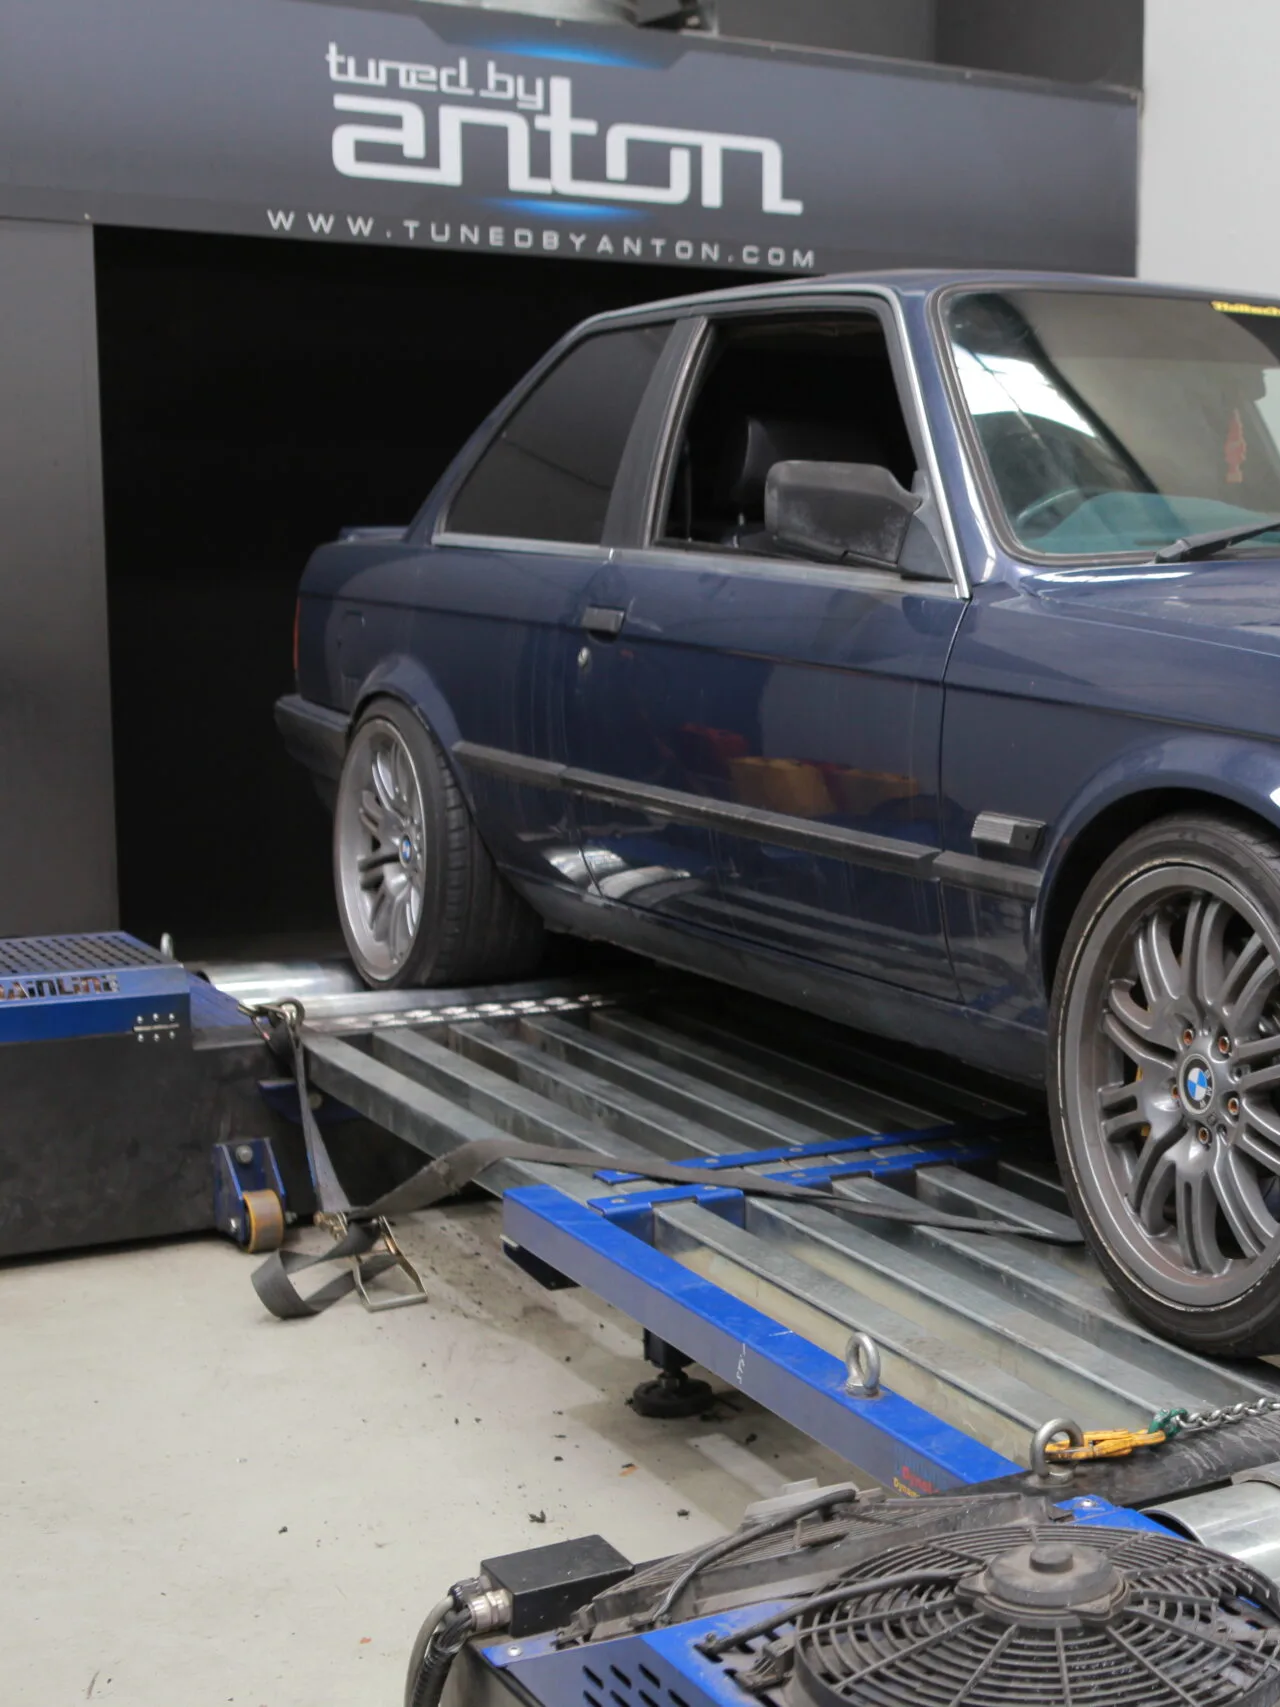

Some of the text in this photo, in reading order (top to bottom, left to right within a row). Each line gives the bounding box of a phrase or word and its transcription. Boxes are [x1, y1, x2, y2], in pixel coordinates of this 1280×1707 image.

[325, 42, 545, 110] tuned by
[332, 76, 804, 215] anton
[267, 208, 815, 269] WWW.TUNEDBYANTON.COM
